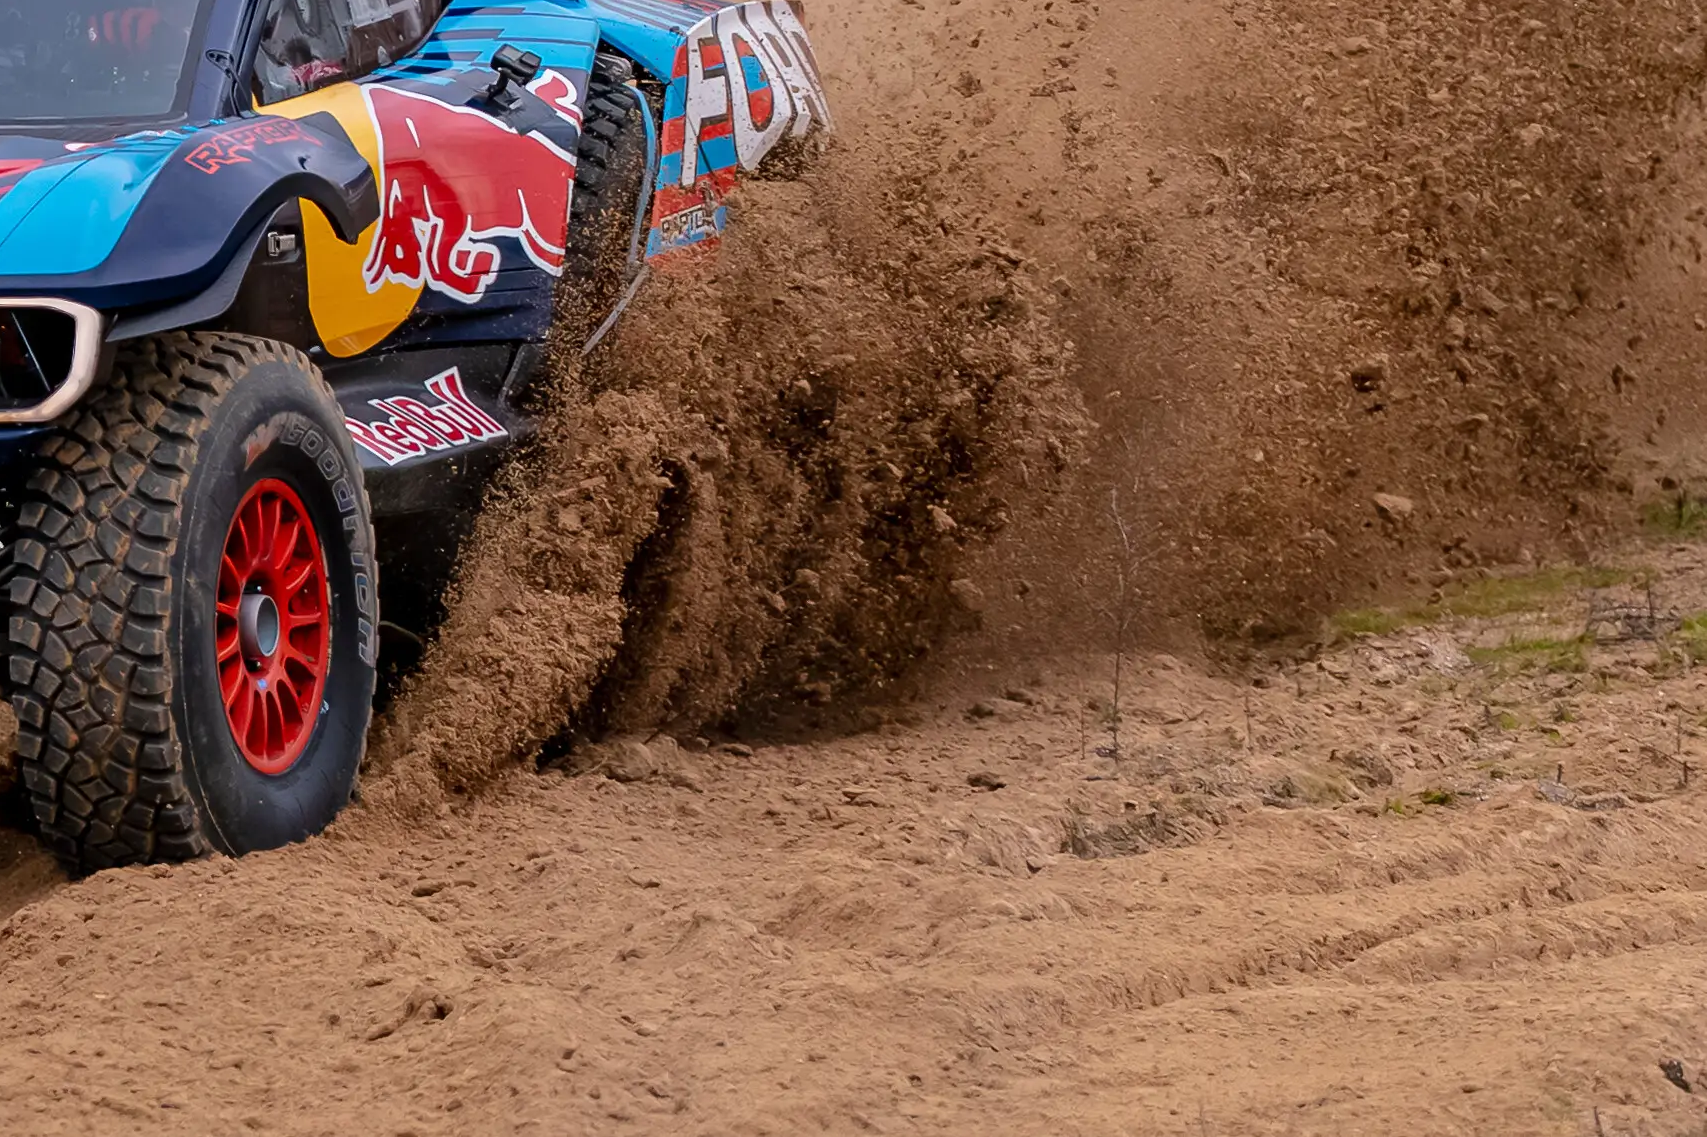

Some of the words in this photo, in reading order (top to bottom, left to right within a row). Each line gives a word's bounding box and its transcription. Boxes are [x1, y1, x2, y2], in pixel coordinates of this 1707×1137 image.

[184, 117, 323, 175] RAPTOR
[345, 398, 454, 467] Red
[383, 365, 509, 447] Bull
